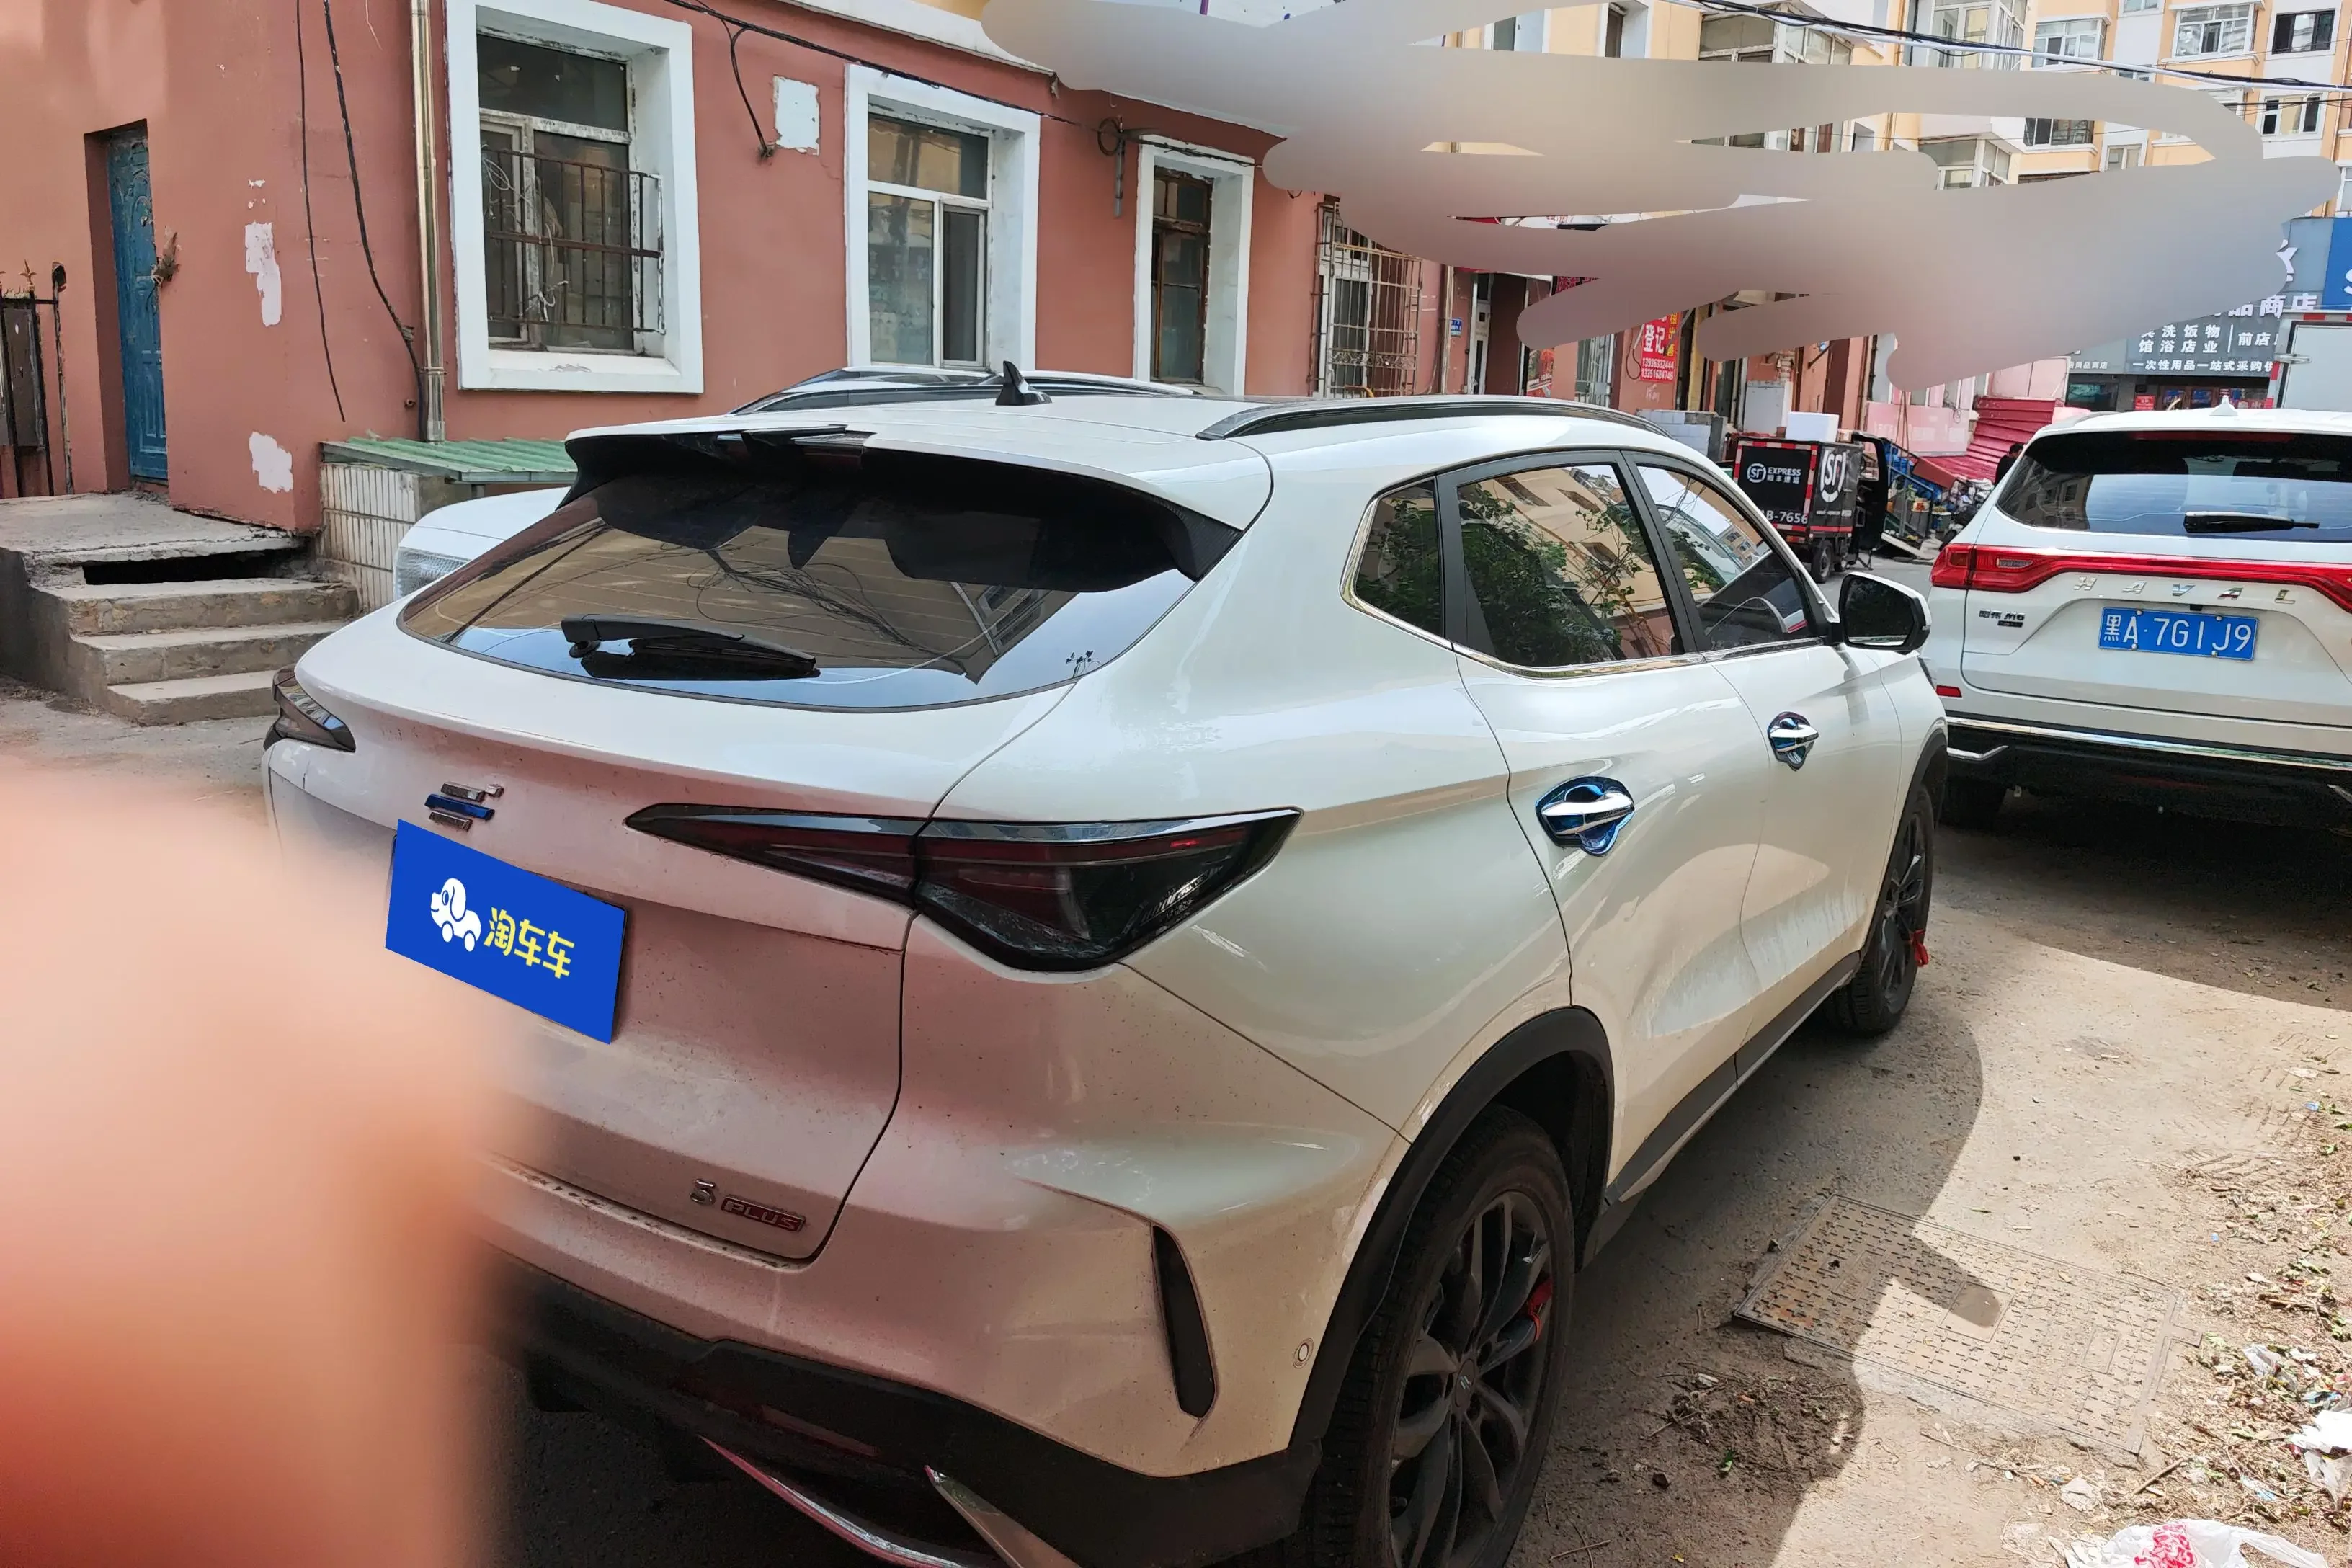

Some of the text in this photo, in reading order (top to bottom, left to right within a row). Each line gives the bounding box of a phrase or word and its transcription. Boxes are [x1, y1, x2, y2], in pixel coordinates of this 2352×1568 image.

[1644, 324, 1665, 353] 登记
[2237, 331, 2278, 347] 前店
[1768, 467, 1801, 476] EXPRESS
[1762, 509, 1809, 524] B-7656
[2073, 576, 2296, 604] HAVAL
[723, 1199, 800, 1231] PLUS
